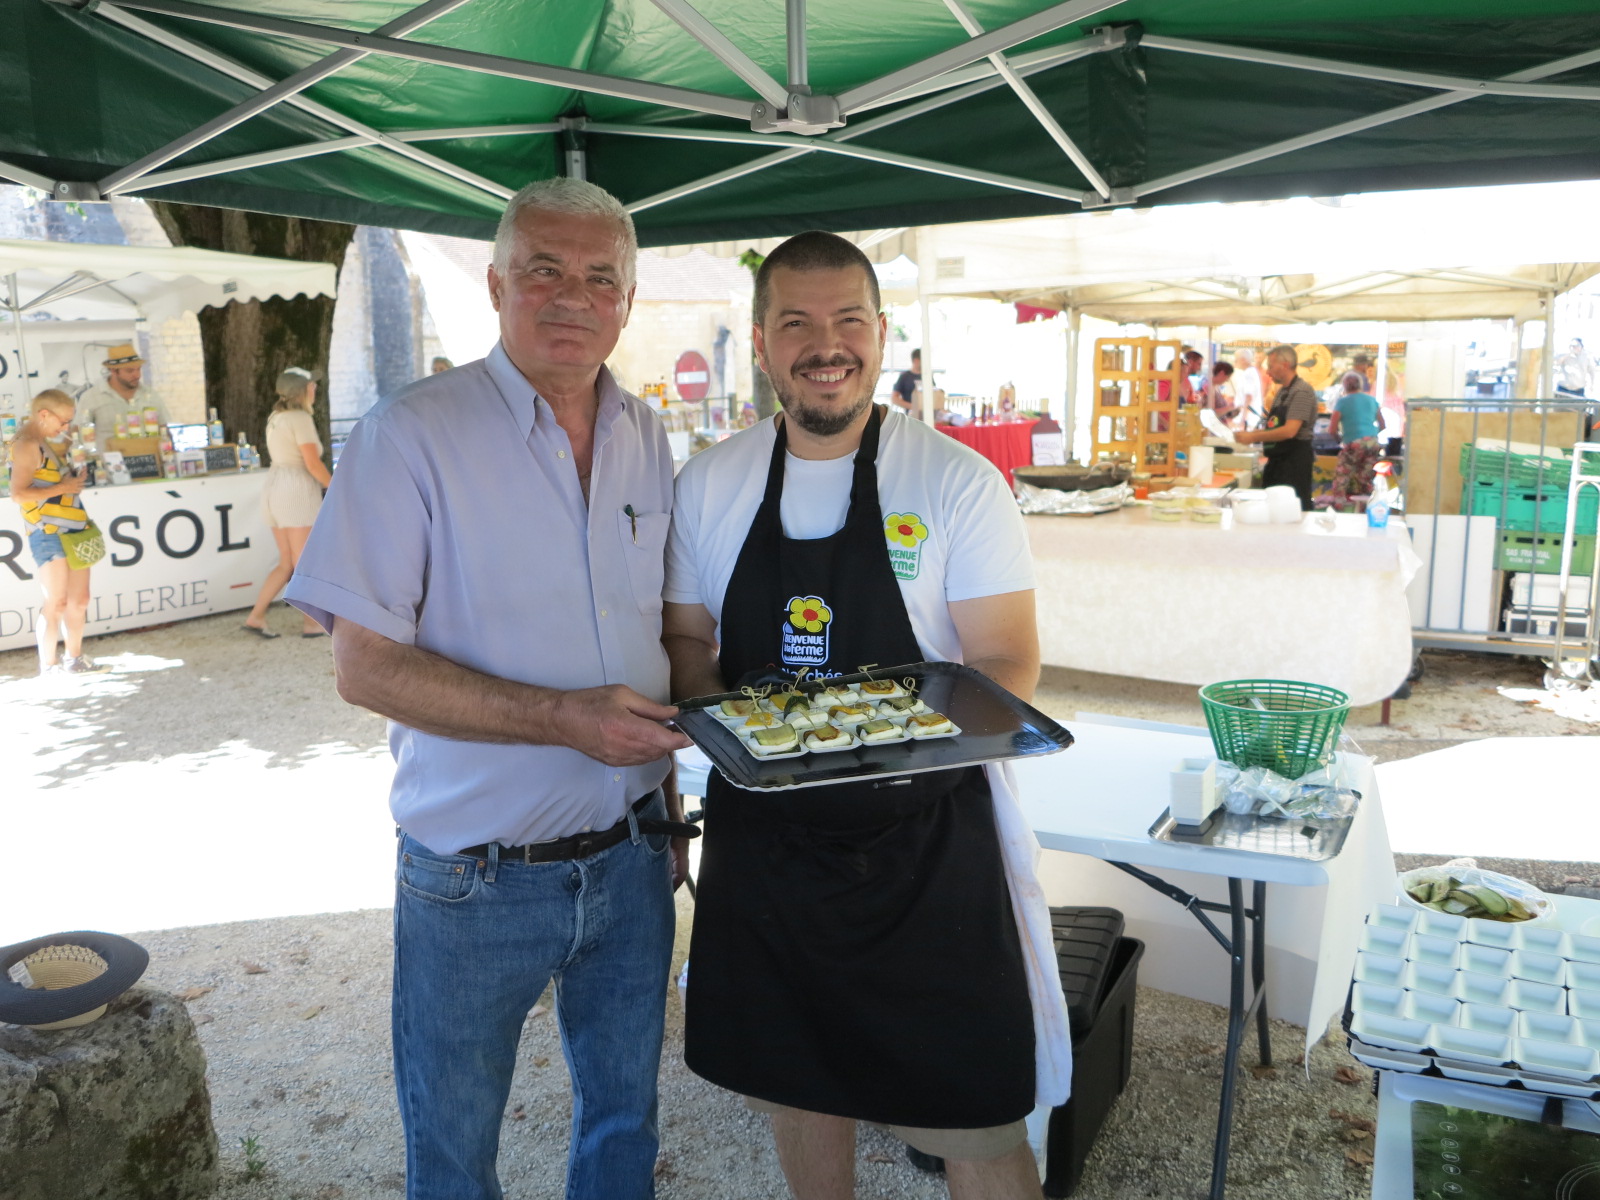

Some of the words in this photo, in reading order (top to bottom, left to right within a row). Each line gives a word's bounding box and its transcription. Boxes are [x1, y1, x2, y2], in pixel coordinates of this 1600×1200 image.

[0, 490, 251, 581] RSÒL
[887, 549, 917, 561] VENUE
[890, 560, 916, 572] rme
[0, 579, 209, 638] DILLERIE
[790, 643, 824, 656] ferme
